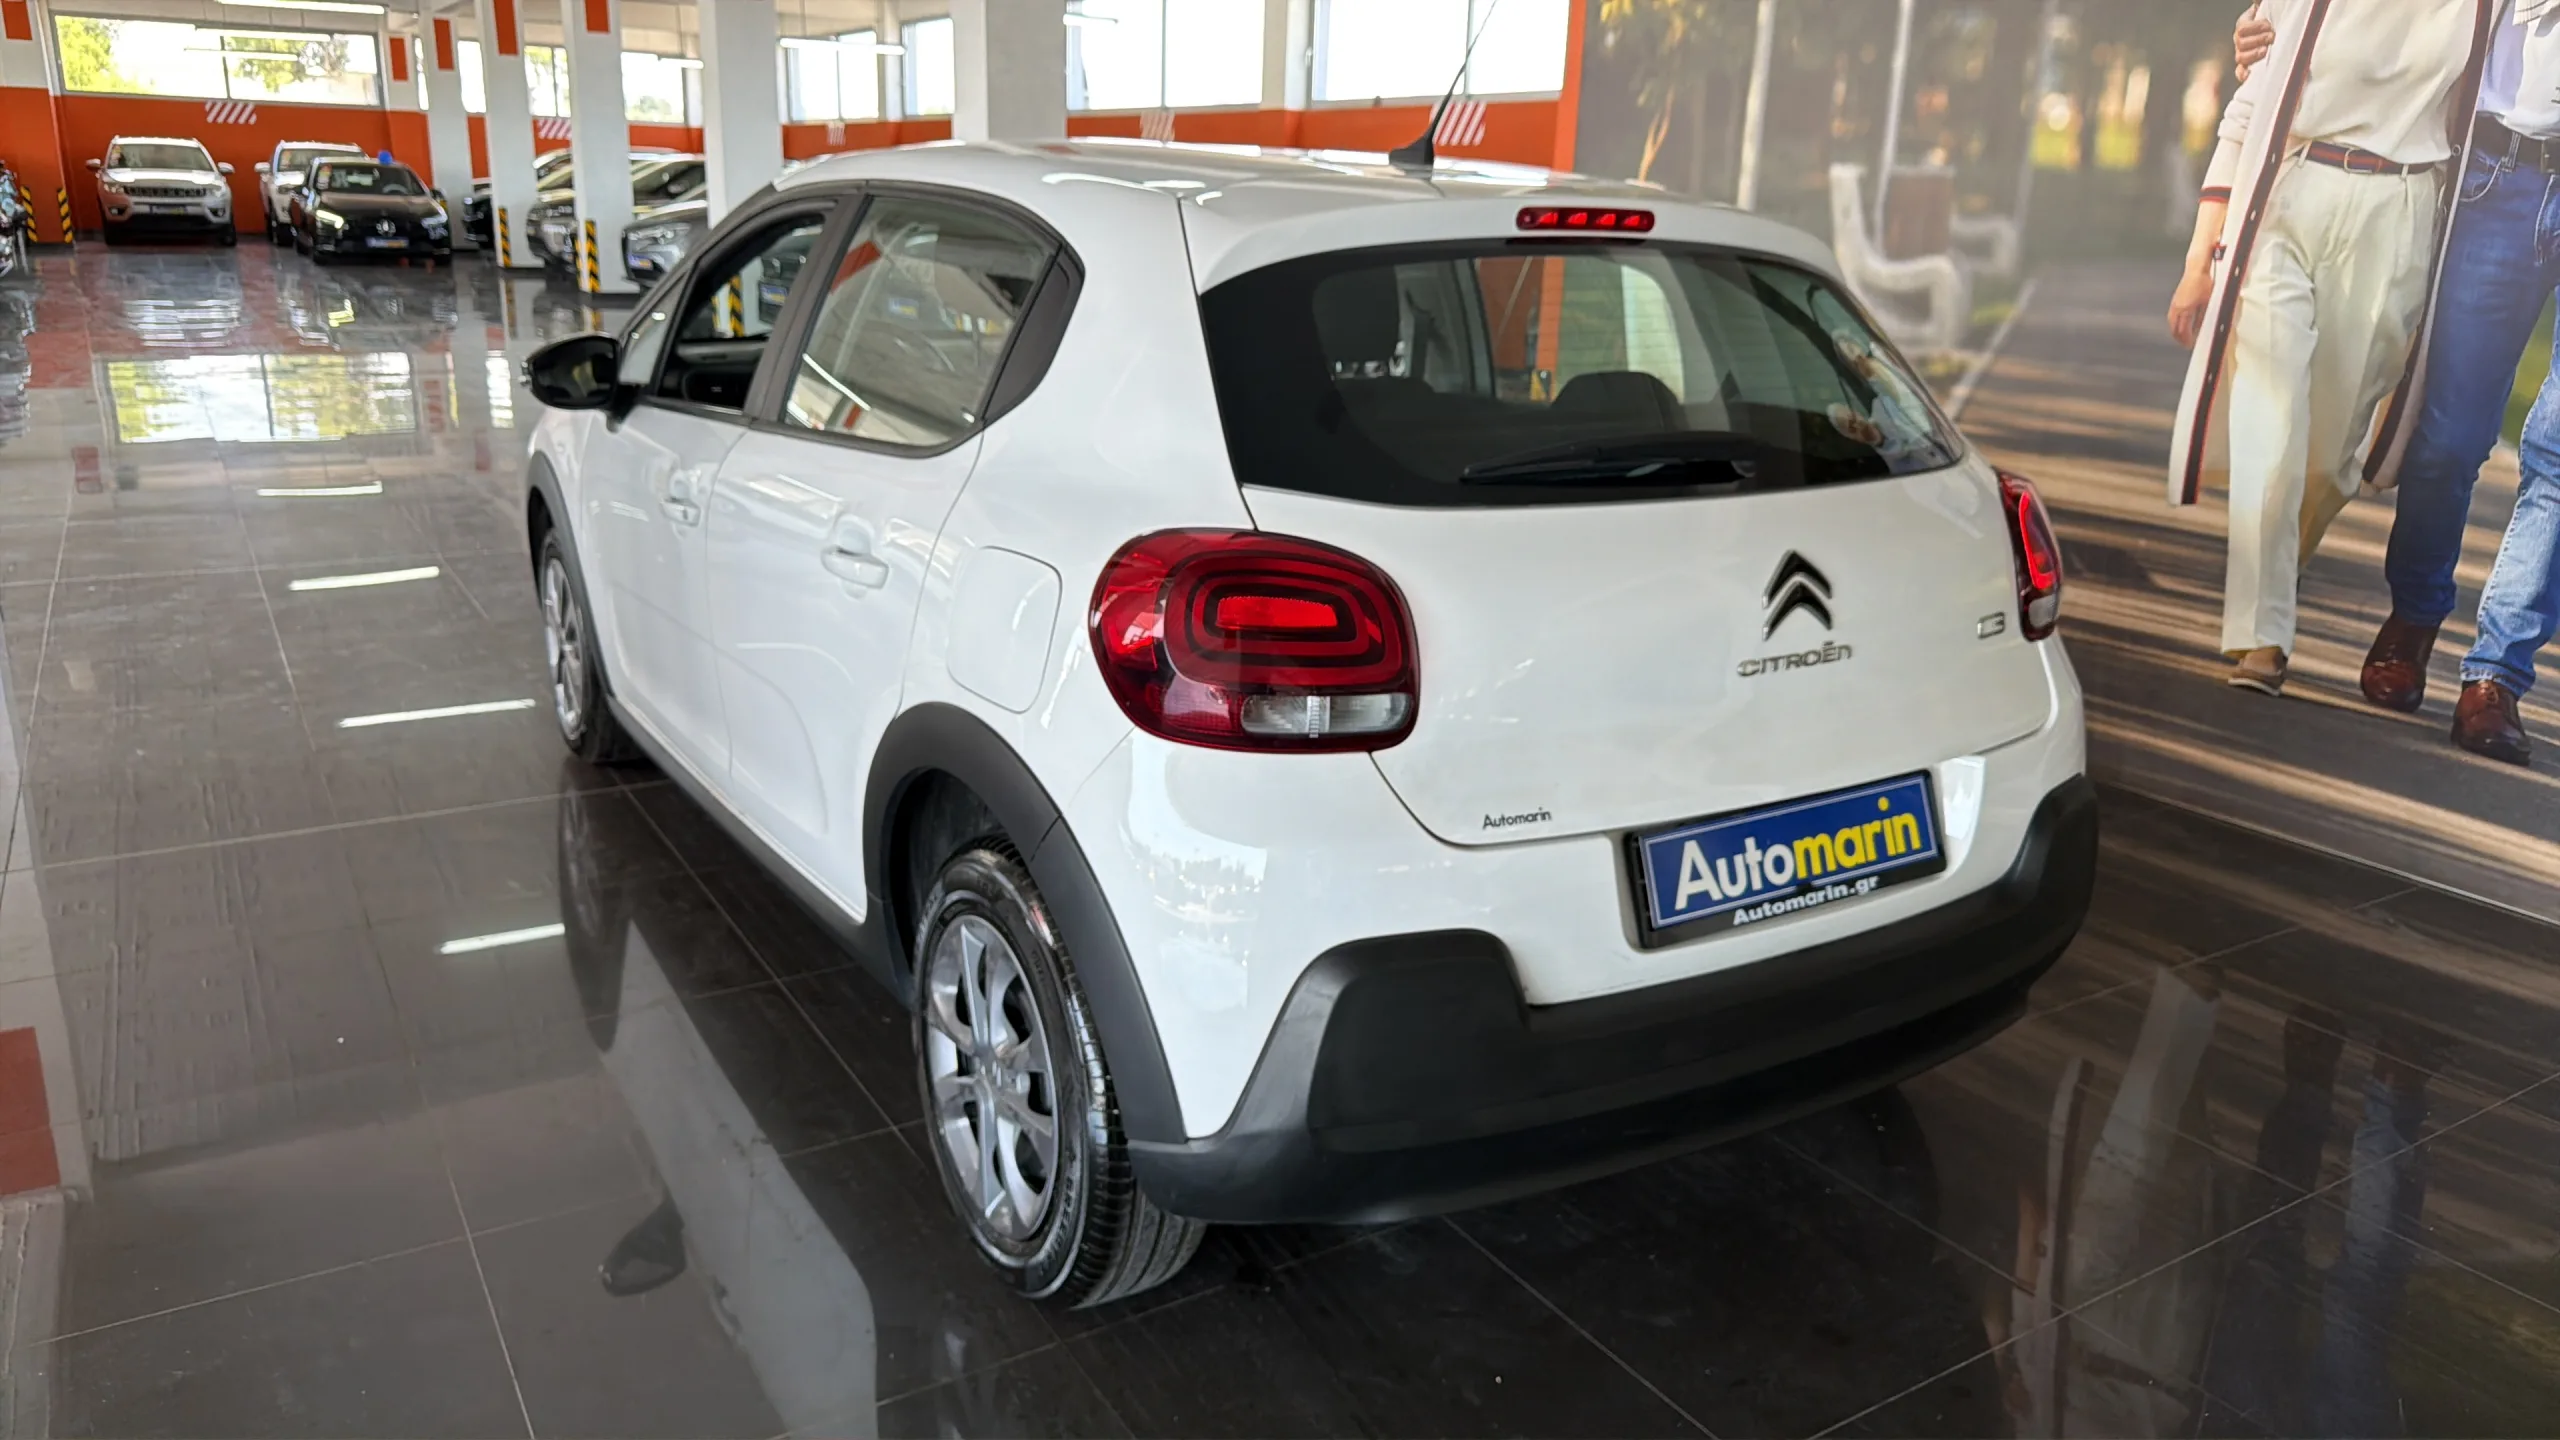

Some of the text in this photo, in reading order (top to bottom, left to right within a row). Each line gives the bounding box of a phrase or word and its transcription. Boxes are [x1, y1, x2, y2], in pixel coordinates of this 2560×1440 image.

[1482, 806, 1552, 830] Automarin
[1674, 796, 1921, 910] Automarin
[1733, 875, 1879, 925] Automarin.gr
